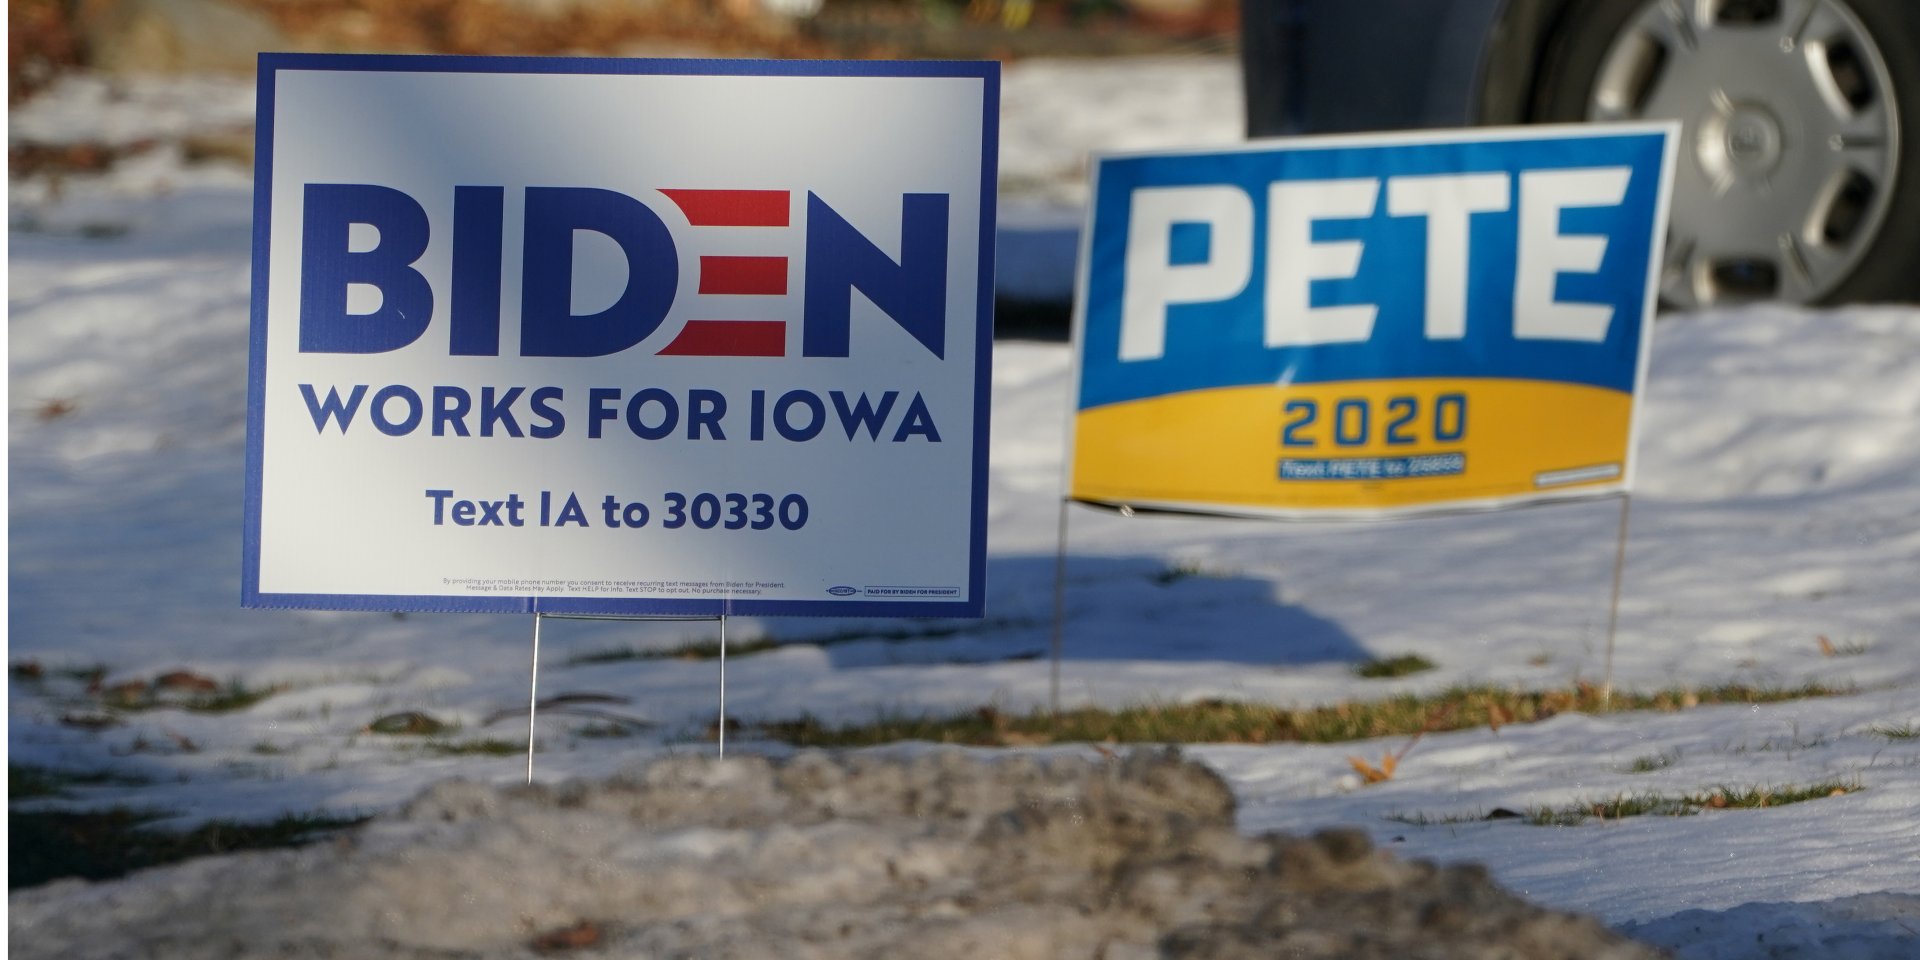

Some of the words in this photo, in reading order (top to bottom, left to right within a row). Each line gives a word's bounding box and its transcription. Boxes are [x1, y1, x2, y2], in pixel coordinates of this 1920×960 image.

[299, 183, 950, 360] BIDEN
[1118, 165, 1632, 362] PETE
[299, 384, 566, 439] WORKS
[587, 387, 727, 441] FOR
[750, 389, 942, 443] IOWA
[1281, 393, 1467, 447] 2020
[425, 489, 525, 526] Text
[539, 491, 588, 528] IA
[602, 494, 650, 529] to
[663, 491, 809, 531] 30330
[443, 577, 450, 586] By
[452, 578, 480, 586] providing
[497, 578, 519, 586] mobile
[520, 579, 540, 587] phone
[567, 580, 580, 588] you
[636, 580, 665, 588] recurring
[666, 580, 679, 588] text
[679, 581, 708, 590] messages
[725, 581, 745, 589] Biden
[745, 581, 754, 589] for
